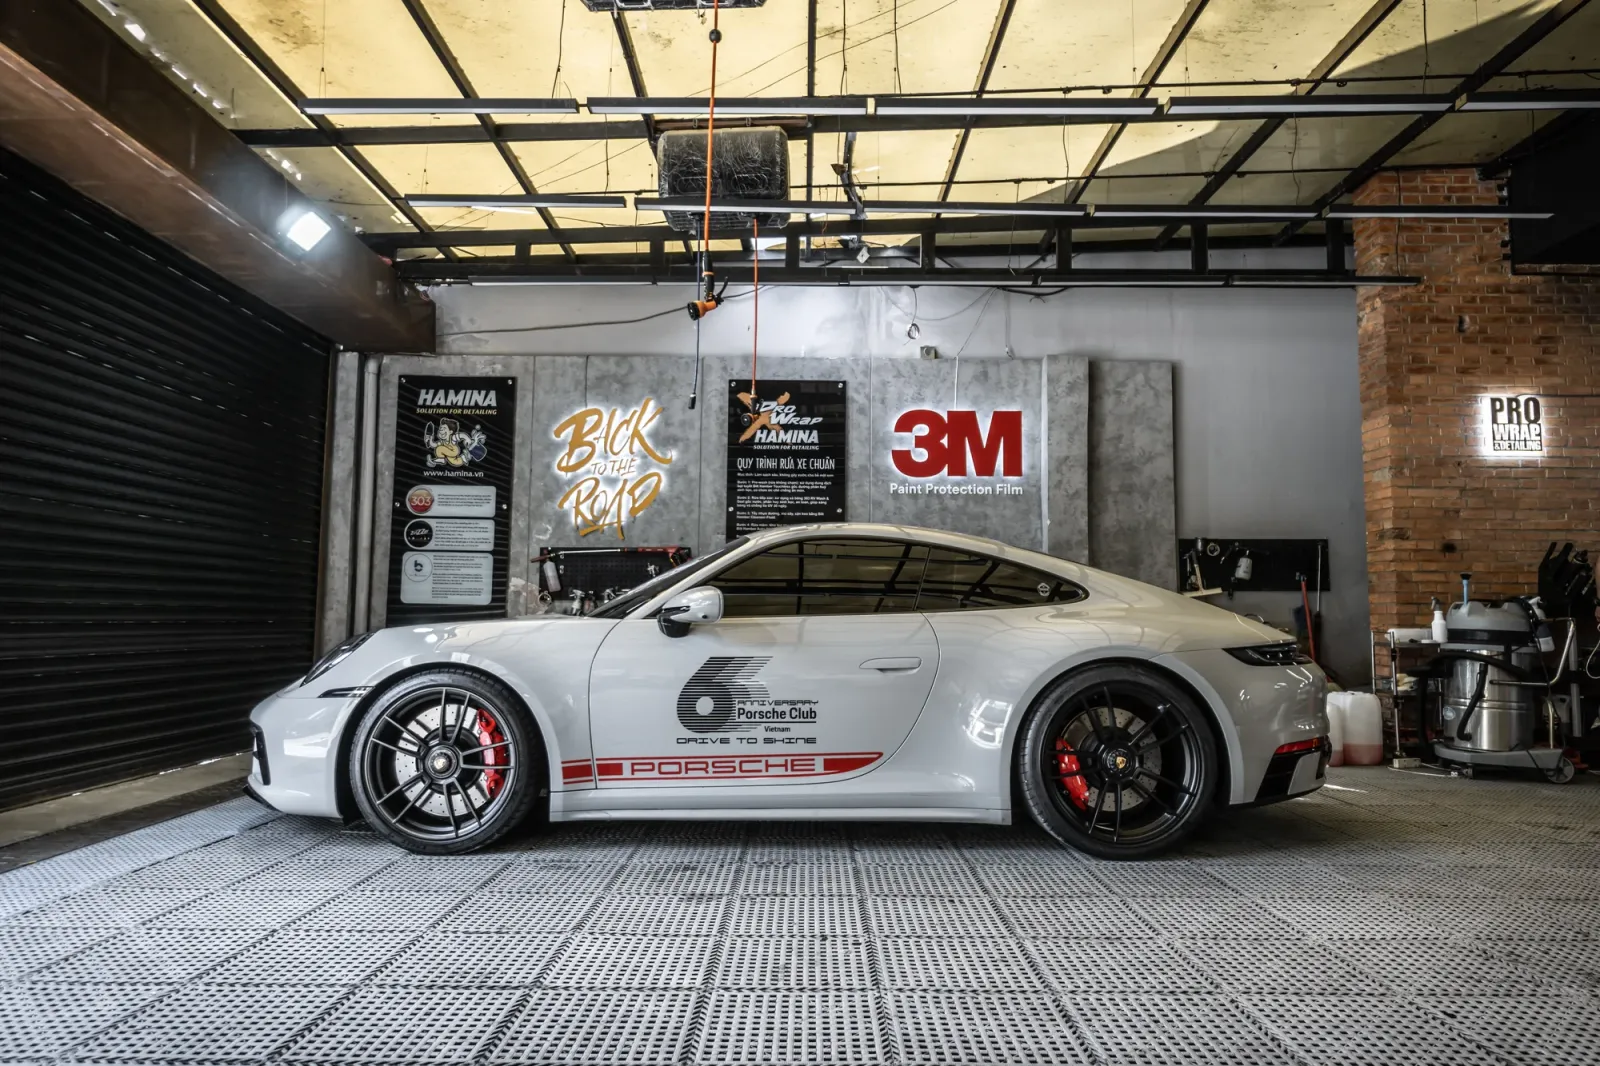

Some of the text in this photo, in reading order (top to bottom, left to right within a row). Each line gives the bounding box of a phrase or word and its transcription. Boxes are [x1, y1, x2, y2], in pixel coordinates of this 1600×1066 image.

[417, 388, 498, 407] HAMINA
[463, 408, 498, 416] DETAILING
[1490, 397, 1541, 425] PRO
[553, 397, 673, 474] BACK
[754, 429, 819, 444] HAMINA
[1492, 423, 1541, 441] WRAP
[891, 409, 1023, 478] 3M
[591, 458, 638, 476] TO THE
[736, 457, 754, 471] QUY
[756, 455, 778, 469] TRÌNH
[797, 458, 808, 470] XE
[423, 469, 484, 478] www.hamina.vn
[890, 483, 1023, 495] Paint Protection Film
[410, 496, 432, 506] 303
[557, 471, 663, 541] ROAD
[737, 707, 817, 719] Porsche Club
[764, 725, 791, 733] Vietnam
[630, 758, 816, 776] PORSCHE
